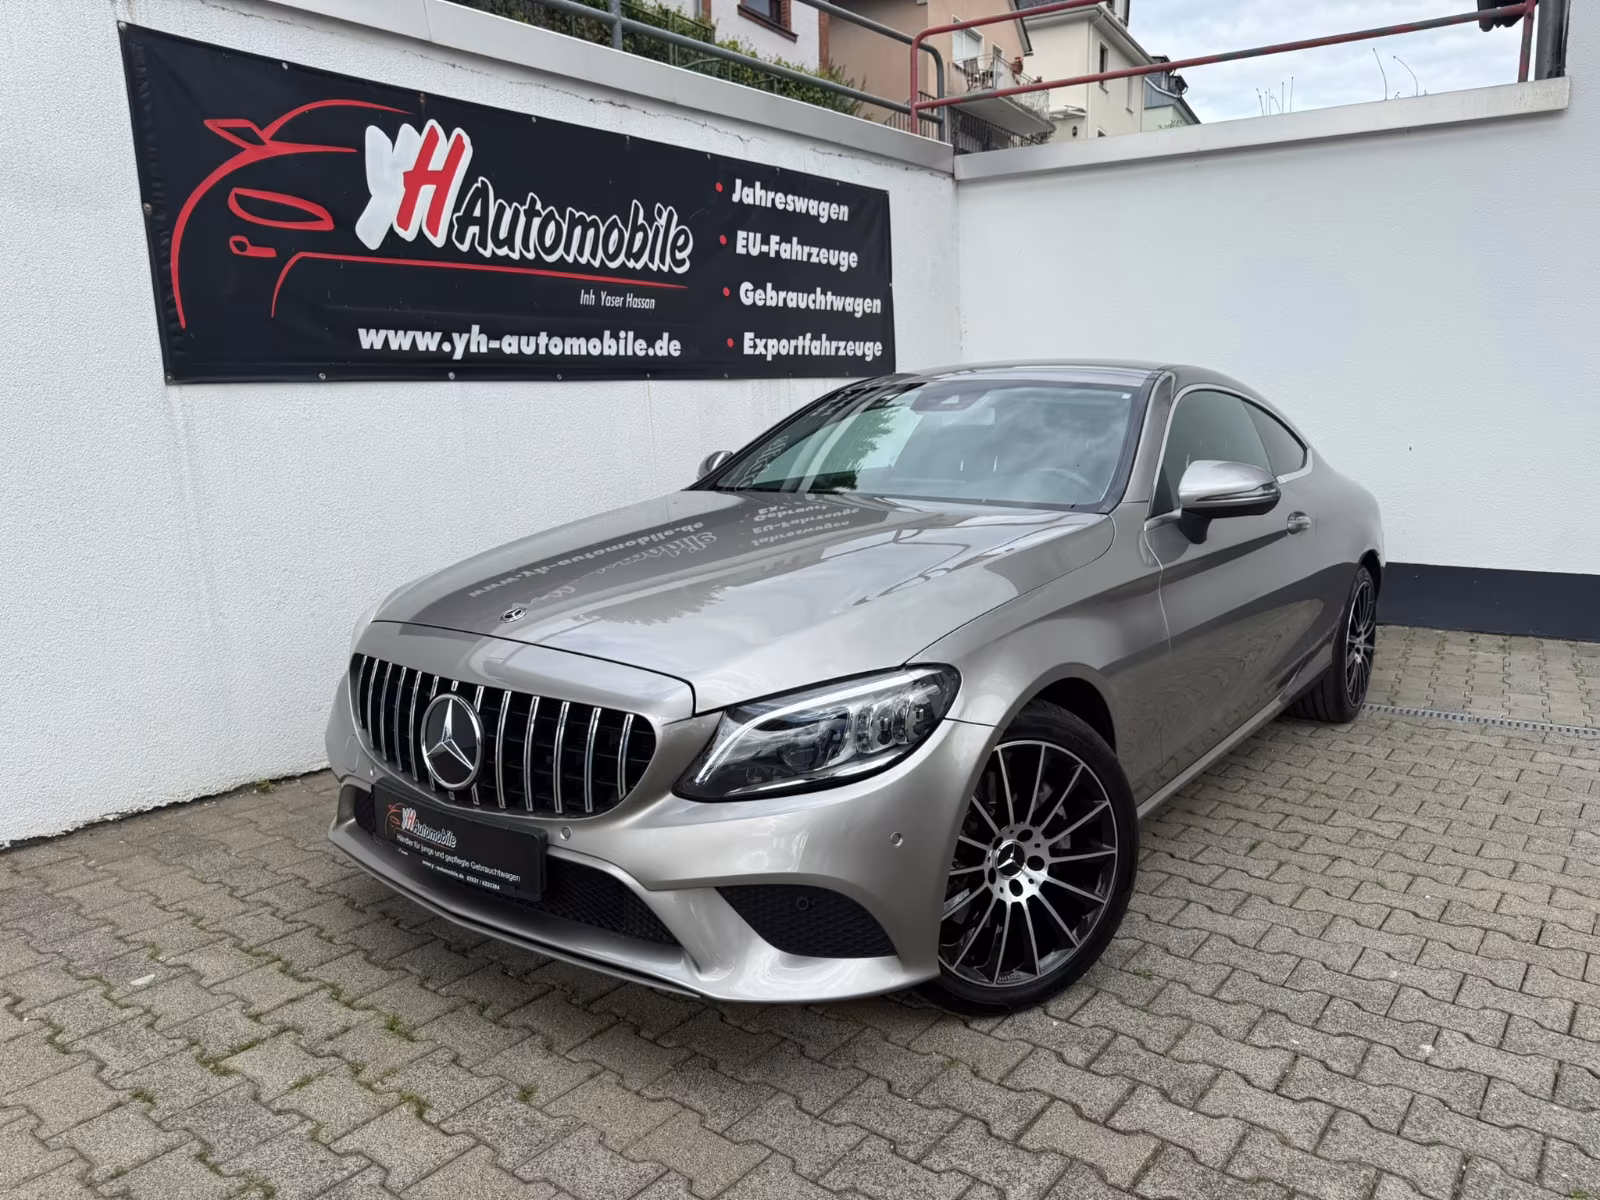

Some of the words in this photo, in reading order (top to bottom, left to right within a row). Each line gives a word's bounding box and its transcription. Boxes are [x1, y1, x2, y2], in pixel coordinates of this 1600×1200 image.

[356, 119, 473, 250] YH
[452, 176, 693, 273] Automobile
[732, 178, 849, 224] Jahreswagen
[736, 230, 858, 272] EU-Fahrzeuge
[580, 289, 595, 306] Inh
[600, 290, 624, 307] Yaser
[626, 292, 656, 309] Hassan
[739, 281, 881, 318] Gebrauchtwagen
[358, 325, 681, 360] www.yh-automobile.de
[743, 332, 882, 361] Exportfahrzeuge
[413, 819, 457, 848] Automobile
[434, 850, 444, 859] und
[470, 861, 521, 882] Gebrauchtwagen
